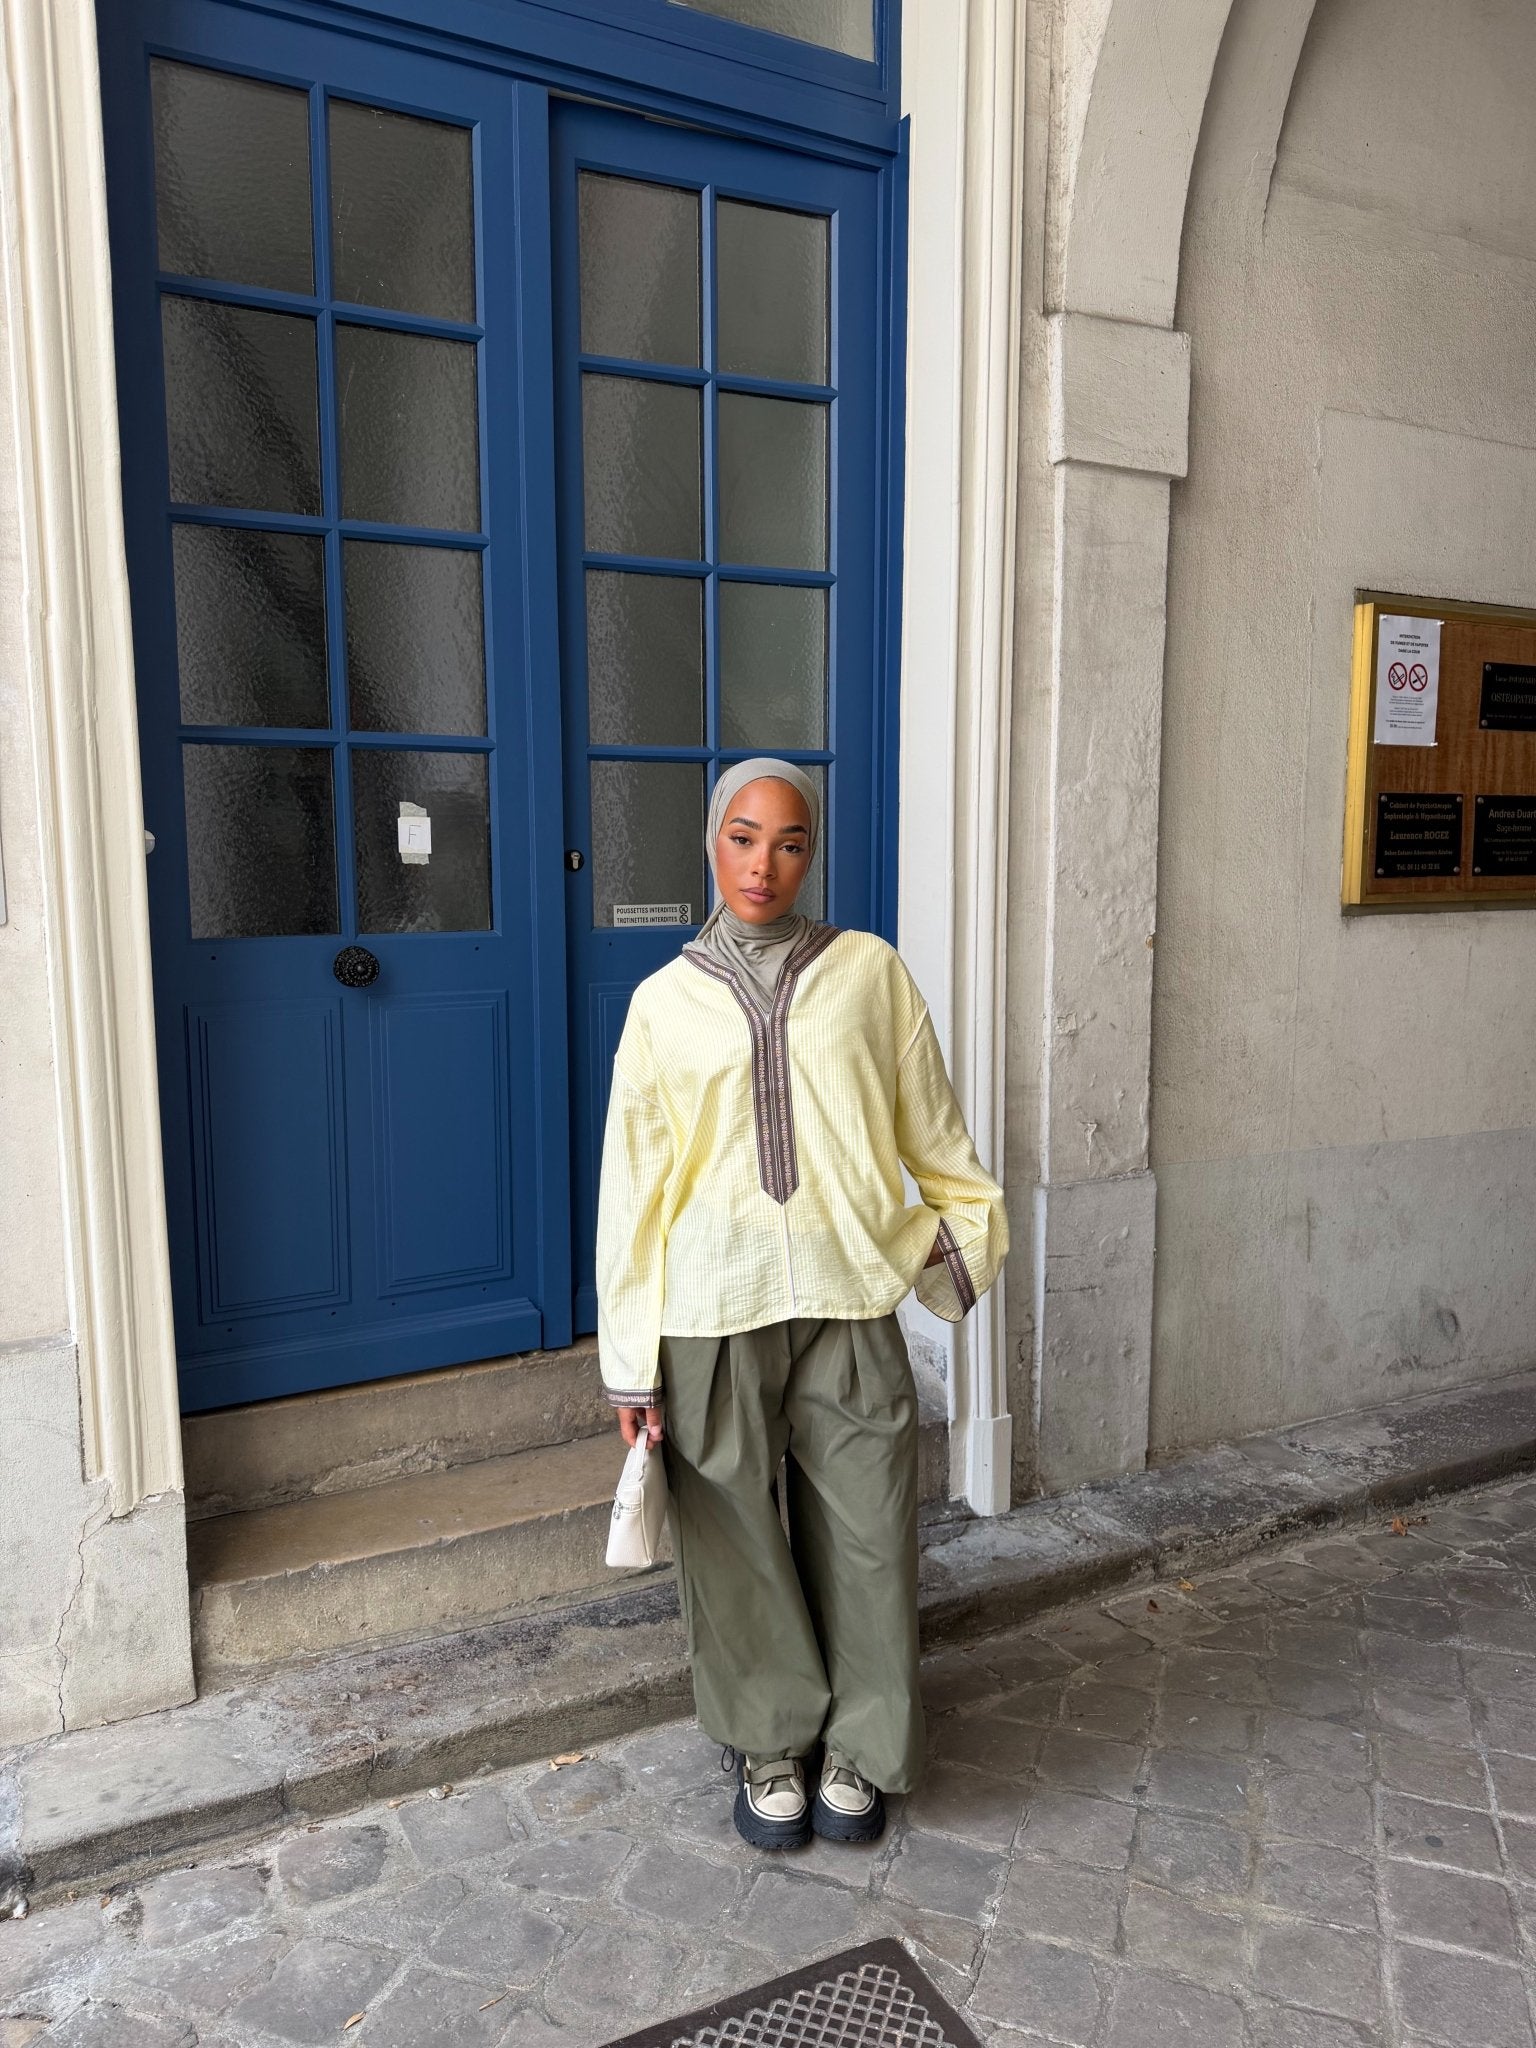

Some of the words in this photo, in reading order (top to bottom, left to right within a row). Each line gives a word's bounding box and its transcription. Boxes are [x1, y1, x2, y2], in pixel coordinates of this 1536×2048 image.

[1488, 808, 1516, 819] Andrea
[408, 824, 422, 845] F
[1390, 830, 1423, 840] Laurence
[649, 906, 678, 914] INTERDITES
